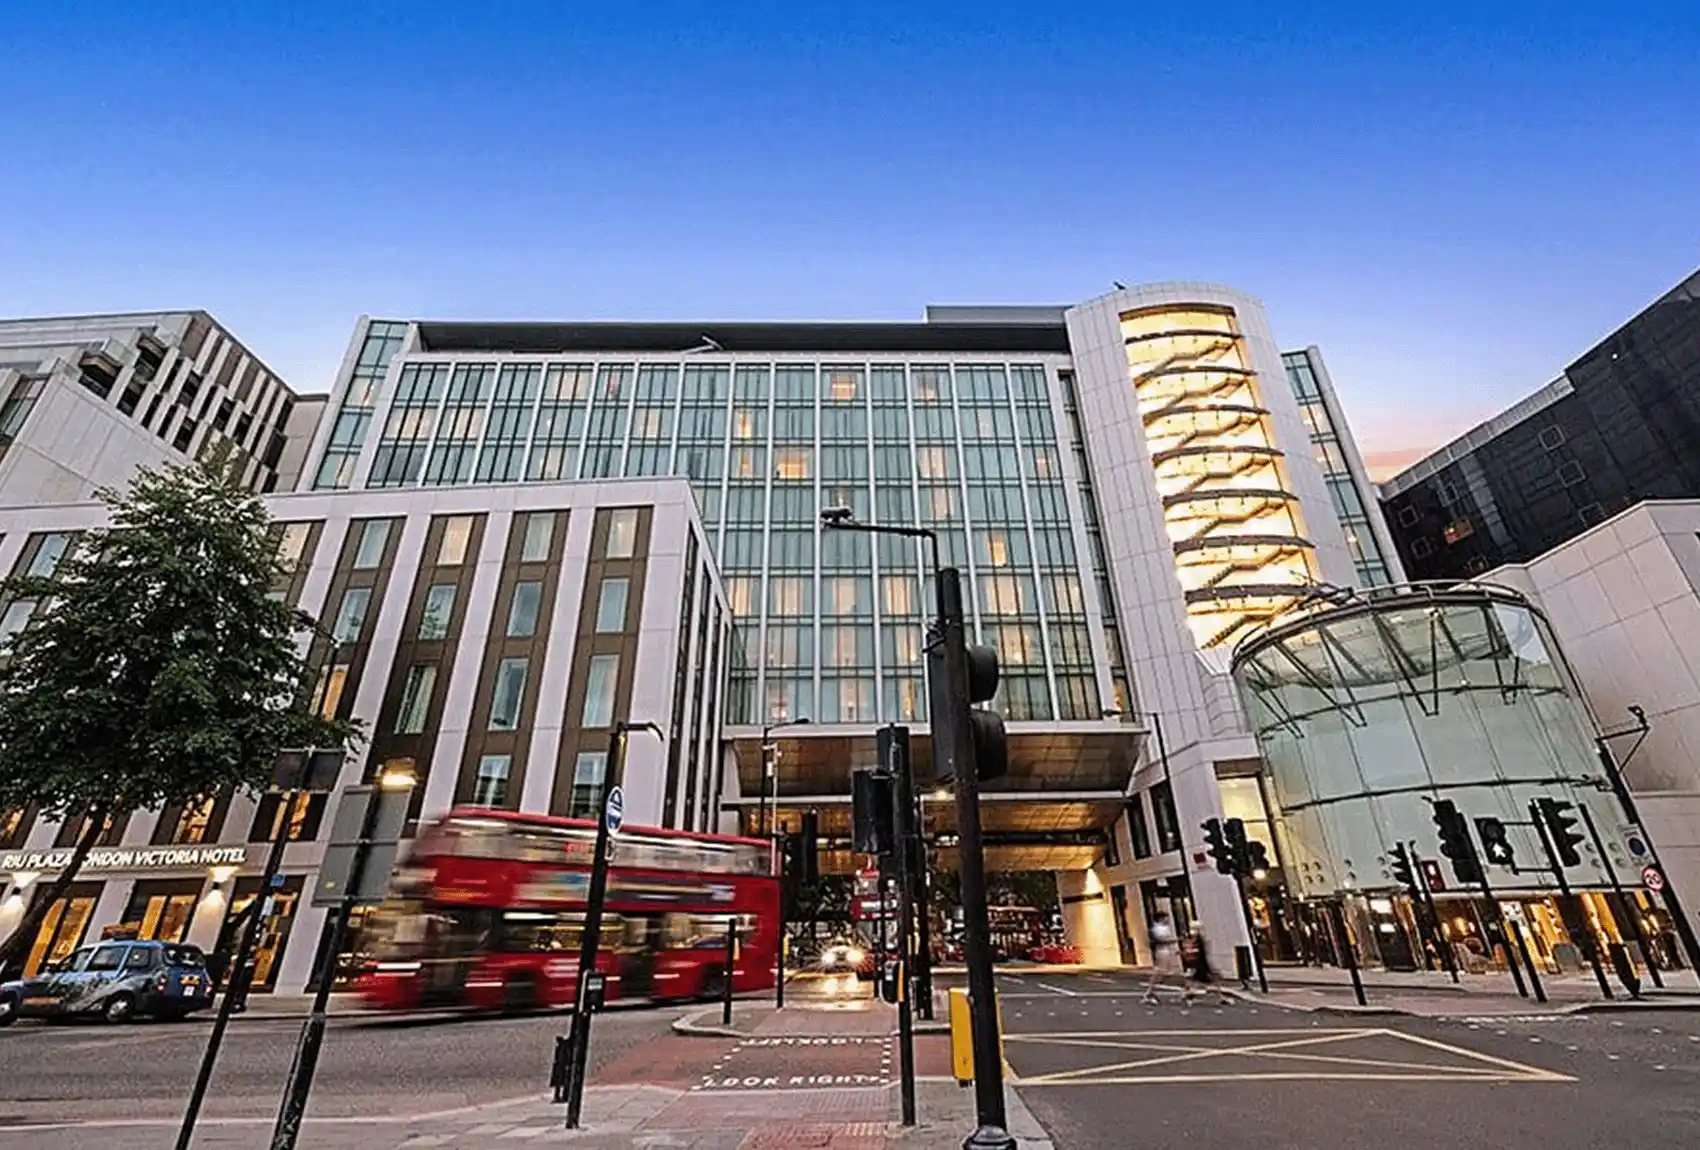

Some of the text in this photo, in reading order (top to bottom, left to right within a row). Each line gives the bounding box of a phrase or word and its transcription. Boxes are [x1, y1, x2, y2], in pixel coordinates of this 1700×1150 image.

[2, 847, 245, 869] RIU PLAZA ONDON VICTORIA HOTEL
[704, 1074, 868, 1087] LOOK RIGHT
